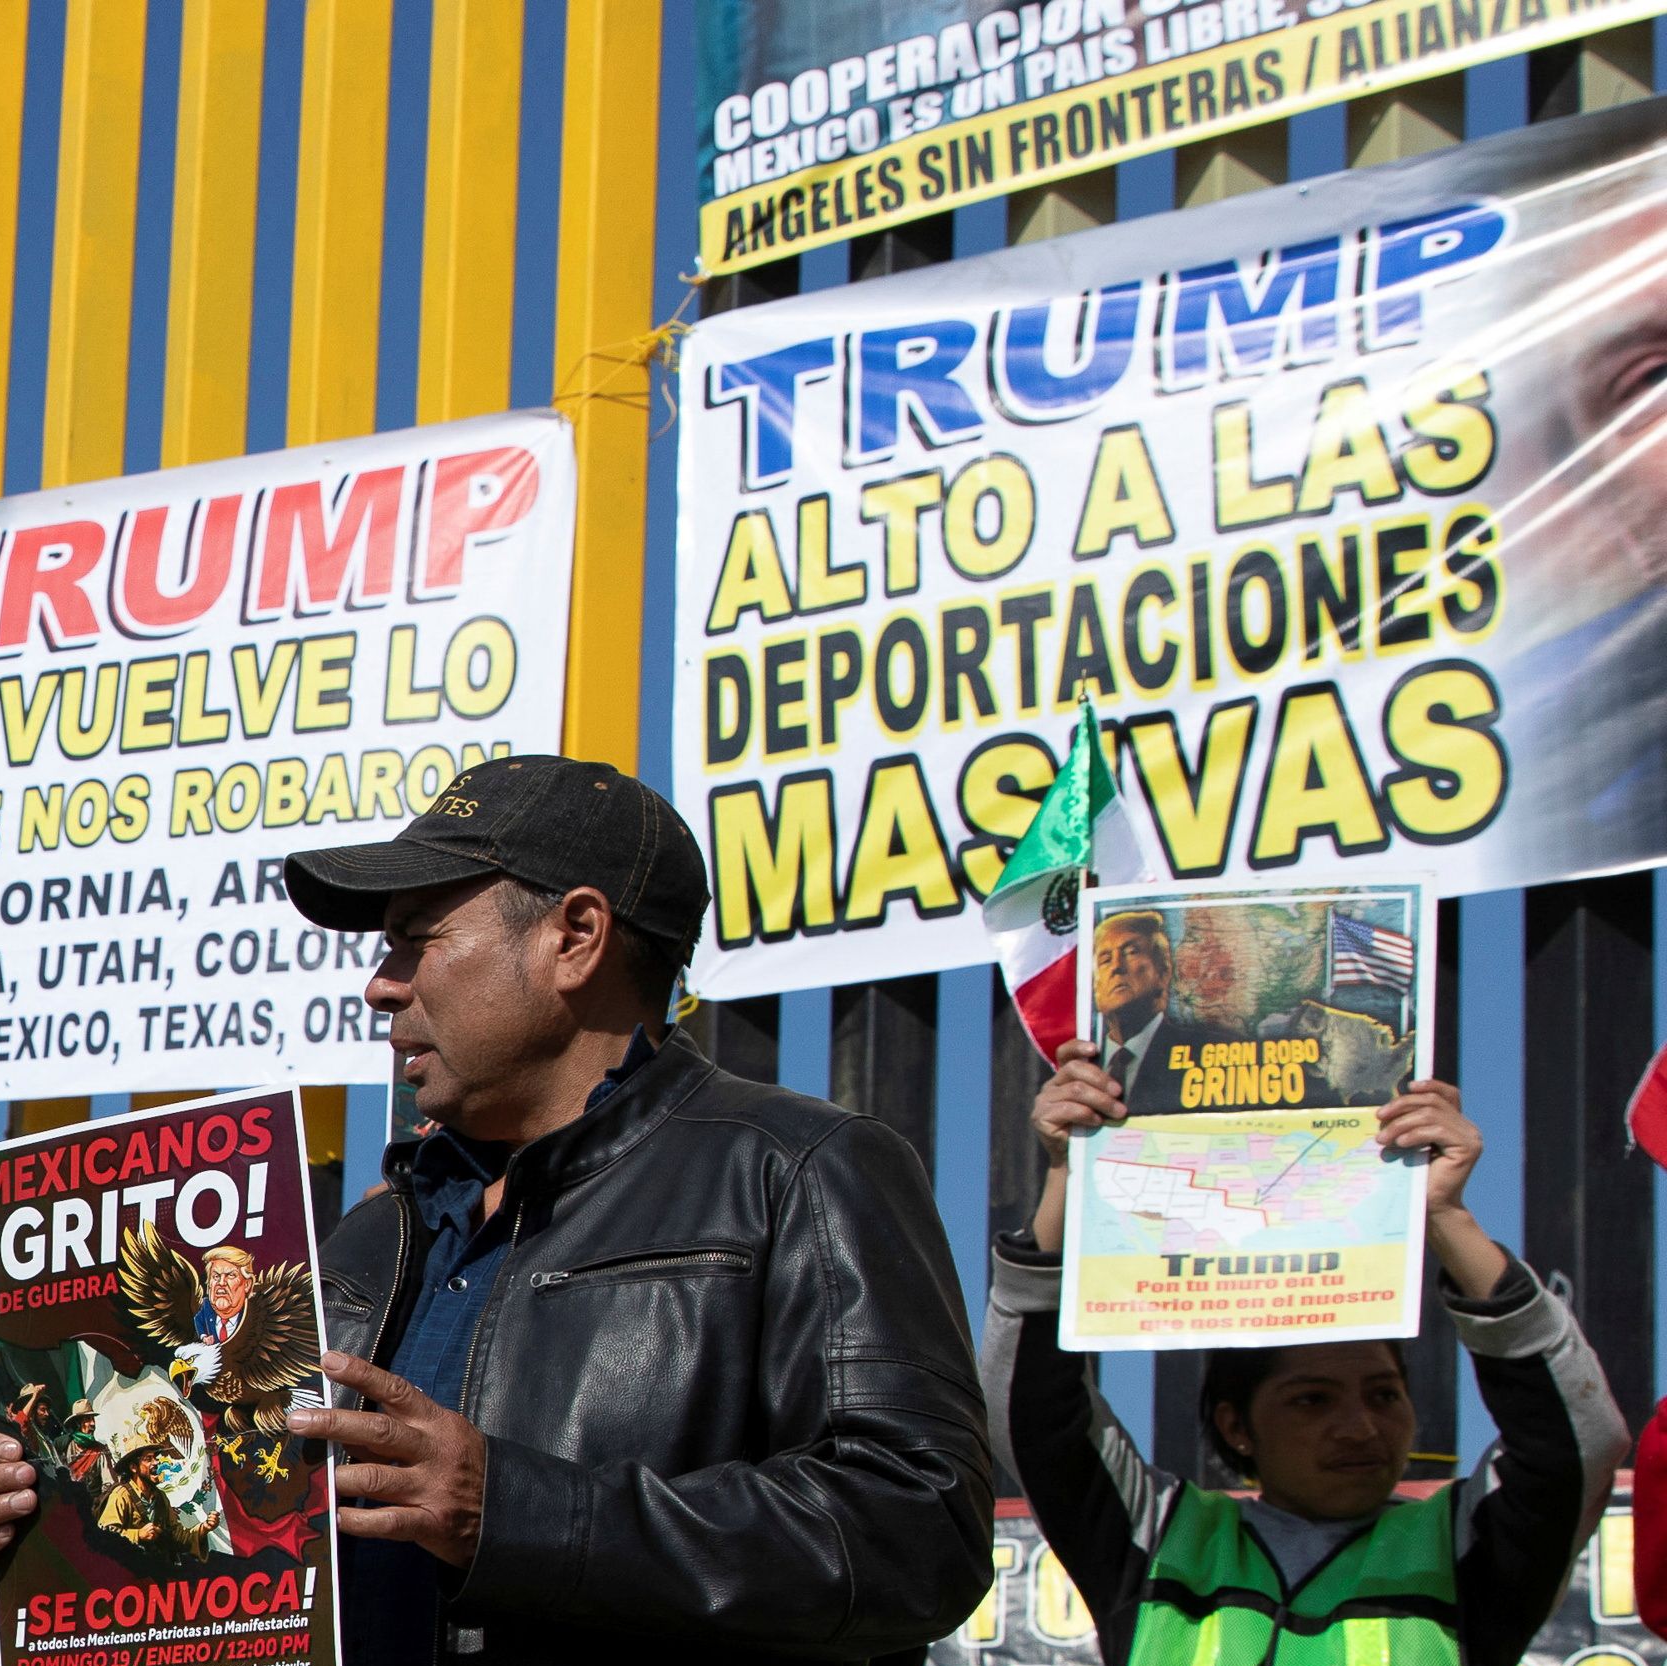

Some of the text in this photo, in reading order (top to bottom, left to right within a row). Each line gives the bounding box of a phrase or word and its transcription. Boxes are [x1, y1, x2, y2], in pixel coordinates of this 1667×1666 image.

[714, 107, 880, 197] MEXICO
[889, 92, 944, 143] ES
[952, 64, 1015, 119] UN
[1024, 27, 1137, 100] PAIS
[723, 48, 1285, 261] ANGELES SIN FRONTERAS
[707, 200, 1515, 492] TRUMP
[705, 365, 1497, 636] ALTO A LAS
[703, 507, 1503, 772] DEPORTACIONES
[383, 615, 516, 725] LO
[19, 774, 149, 853] NOS
[37, 937, 173, 990] UTAH,
[139, 1002, 285, 1056] TEXAS,
[1169, 1037, 1320, 1070] EL GRAN ROBO
[1180, 1063, 1306, 1109] GRINGO
[1312, 1119, 1360, 1129] MURO
[27, 1272, 119, 1310] GUERRA
[1160, 1251, 1340, 1278] Trump
[15, 1567, 317, 1647] ¡SE CONVOCA!
[28, 1614, 308, 1651] a todos los Mexicanos Patriotas a la Manifestación
[145, 1643, 211, 1666] ENERO
[226, 1638, 277, 1659] 12:00
[280, 1633, 310, 1655] PM
